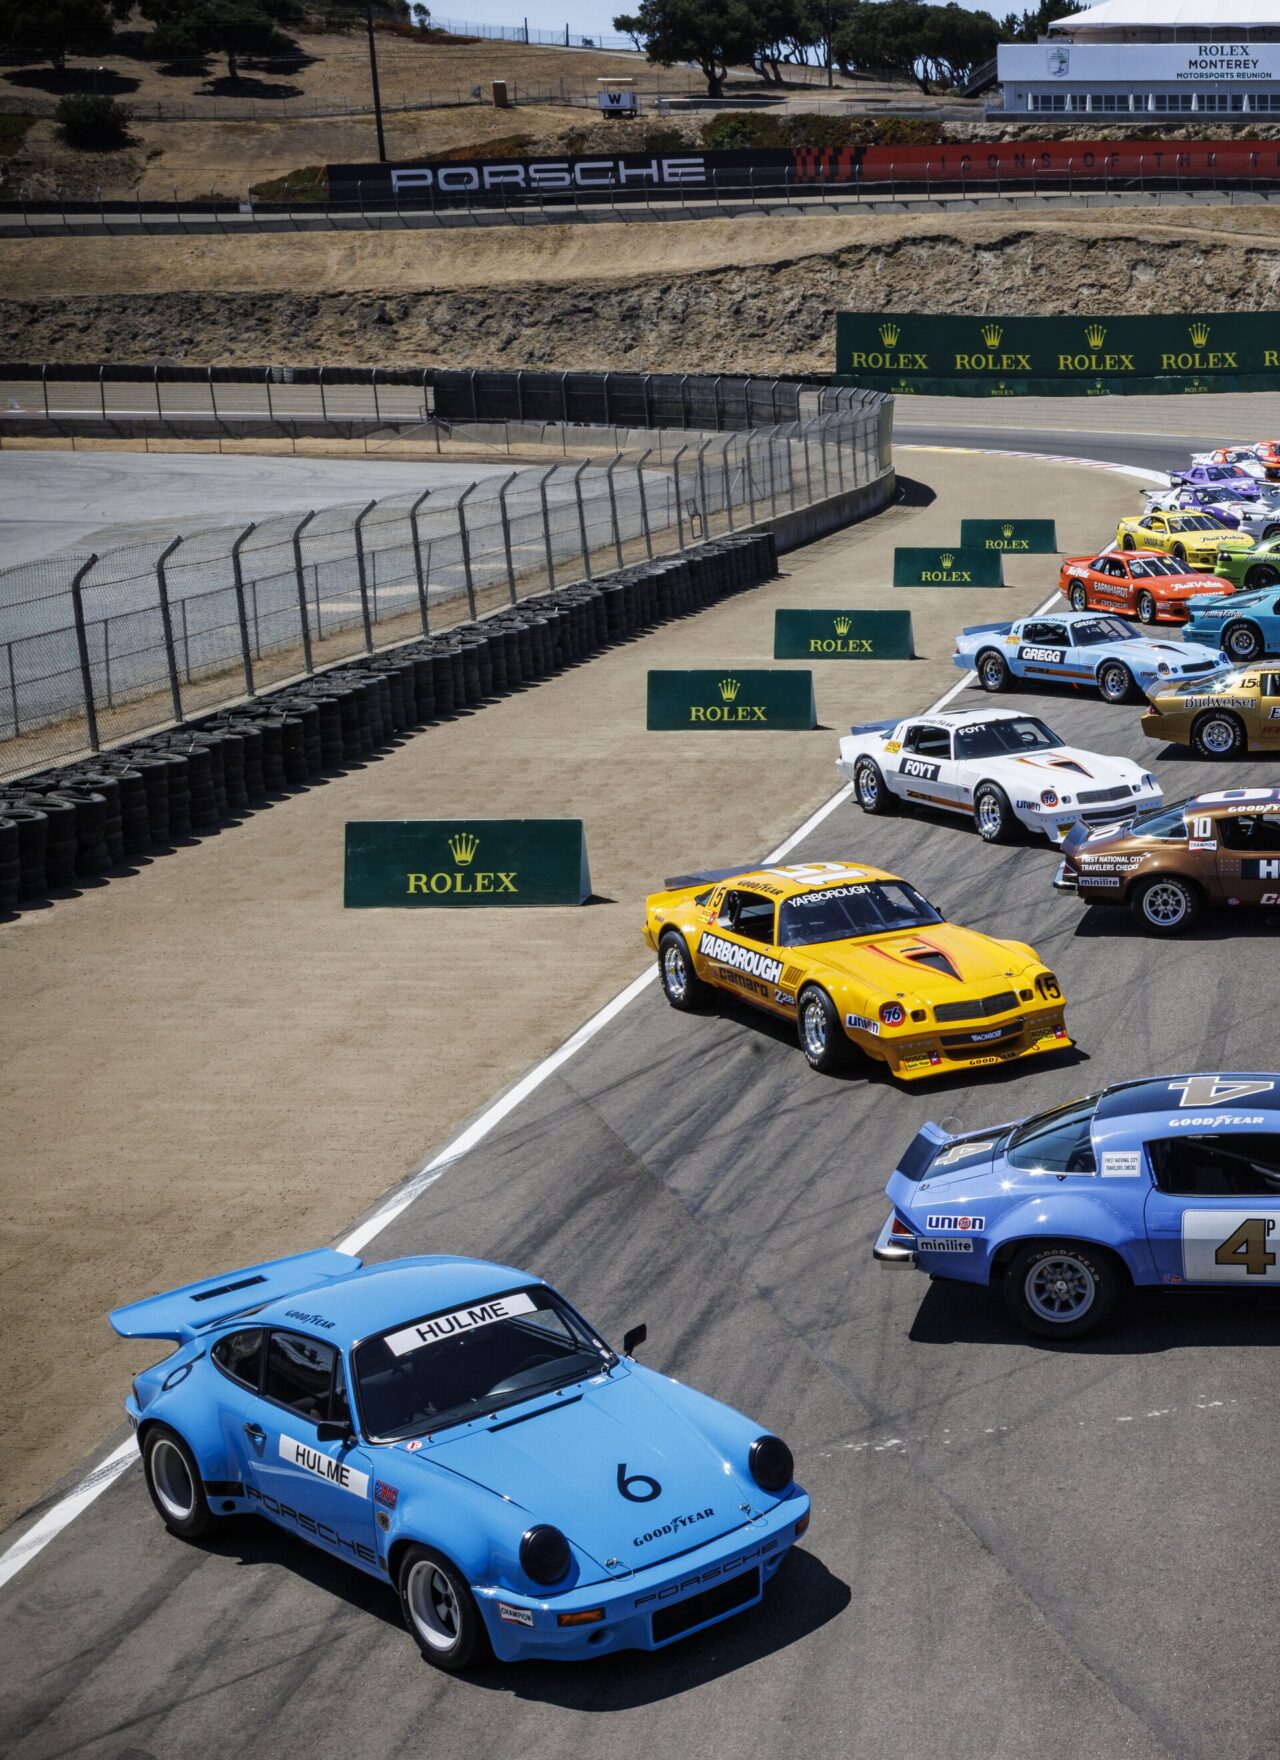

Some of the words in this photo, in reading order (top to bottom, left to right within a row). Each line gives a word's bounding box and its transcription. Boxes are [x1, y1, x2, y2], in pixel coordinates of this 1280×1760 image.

[1198, 45, 1250, 56] ROLEX
[1188, 59, 1259, 69] MONTEREY
[608, 94, 621, 104] W
[939, 153, 1052, 171] ICONS
[1083, 152, 1120, 167] OF
[1153, 152, 1216, 167] THE
[390, 157, 706, 192] PORSCHE
[852, 352, 930, 370] ROLEX
[954, 354, 1033, 371] ROLEX
[1058, 354, 1136, 371] ROLEX
[1161, 353, 1239, 370] ROLEX
[891, 386, 915, 394] ROLEX
[985, 540, 1029, 550] ROLEX
[921, 571, 971, 582] ROLEX
[1094, 582, 1128, 598] EARNHARDT
[1013, 624, 1021, 636] 4
[810, 639, 874, 652] ROLEX
[1022, 648, 1061, 663] GREGG
[1184, 695, 1257, 709] Budweiser
[689, 706, 768, 721] ROLEX
[959, 724, 987, 735] FOYT
[904, 760, 935, 778] FOYT
[1044, 795, 1055, 804] 76
[1192, 817, 1212, 838] 10
[1099, 855, 1129, 863] NATIONAL
[406, 872, 519, 893] ROLEX
[737, 880, 784, 896] GOODYEAR
[1081, 878, 1118, 886] minilite
[708, 885, 728, 908] 15
[787, 885, 871, 909] YARBOROUGH
[700, 932, 783, 985] YARBOROUGH
[718, 967, 770, 998] camaro
[1035, 975, 1061, 1000] 15
[774, 989, 795, 1006] Z28
[883, 1006, 901, 1023] 76
[1168, 1076, 1275, 1107] 4
[1168, 1115, 1264, 1128] GOODYEAR
[934, 1142, 994, 1166] 4
[1266, 1219, 1276, 1237] P
[920, 1238, 972, 1252] minilite
[1215, 1218, 1276, 1275] 4
[284, 1309, 336, 1330] GOODYEAR
[416, 1301, 509, 1342] HULME
[295, 1444, 350, 1488] HULME
[616, 1463, 662, 1503] 6
[247, 1485, 380, 1558] PORSCHE
[632, 1507, 715, 1548] GOODYEAR
[633, 1538, 779, 1609] PORSCHE
[500, 1607, 532, 1623] CHAMPION
